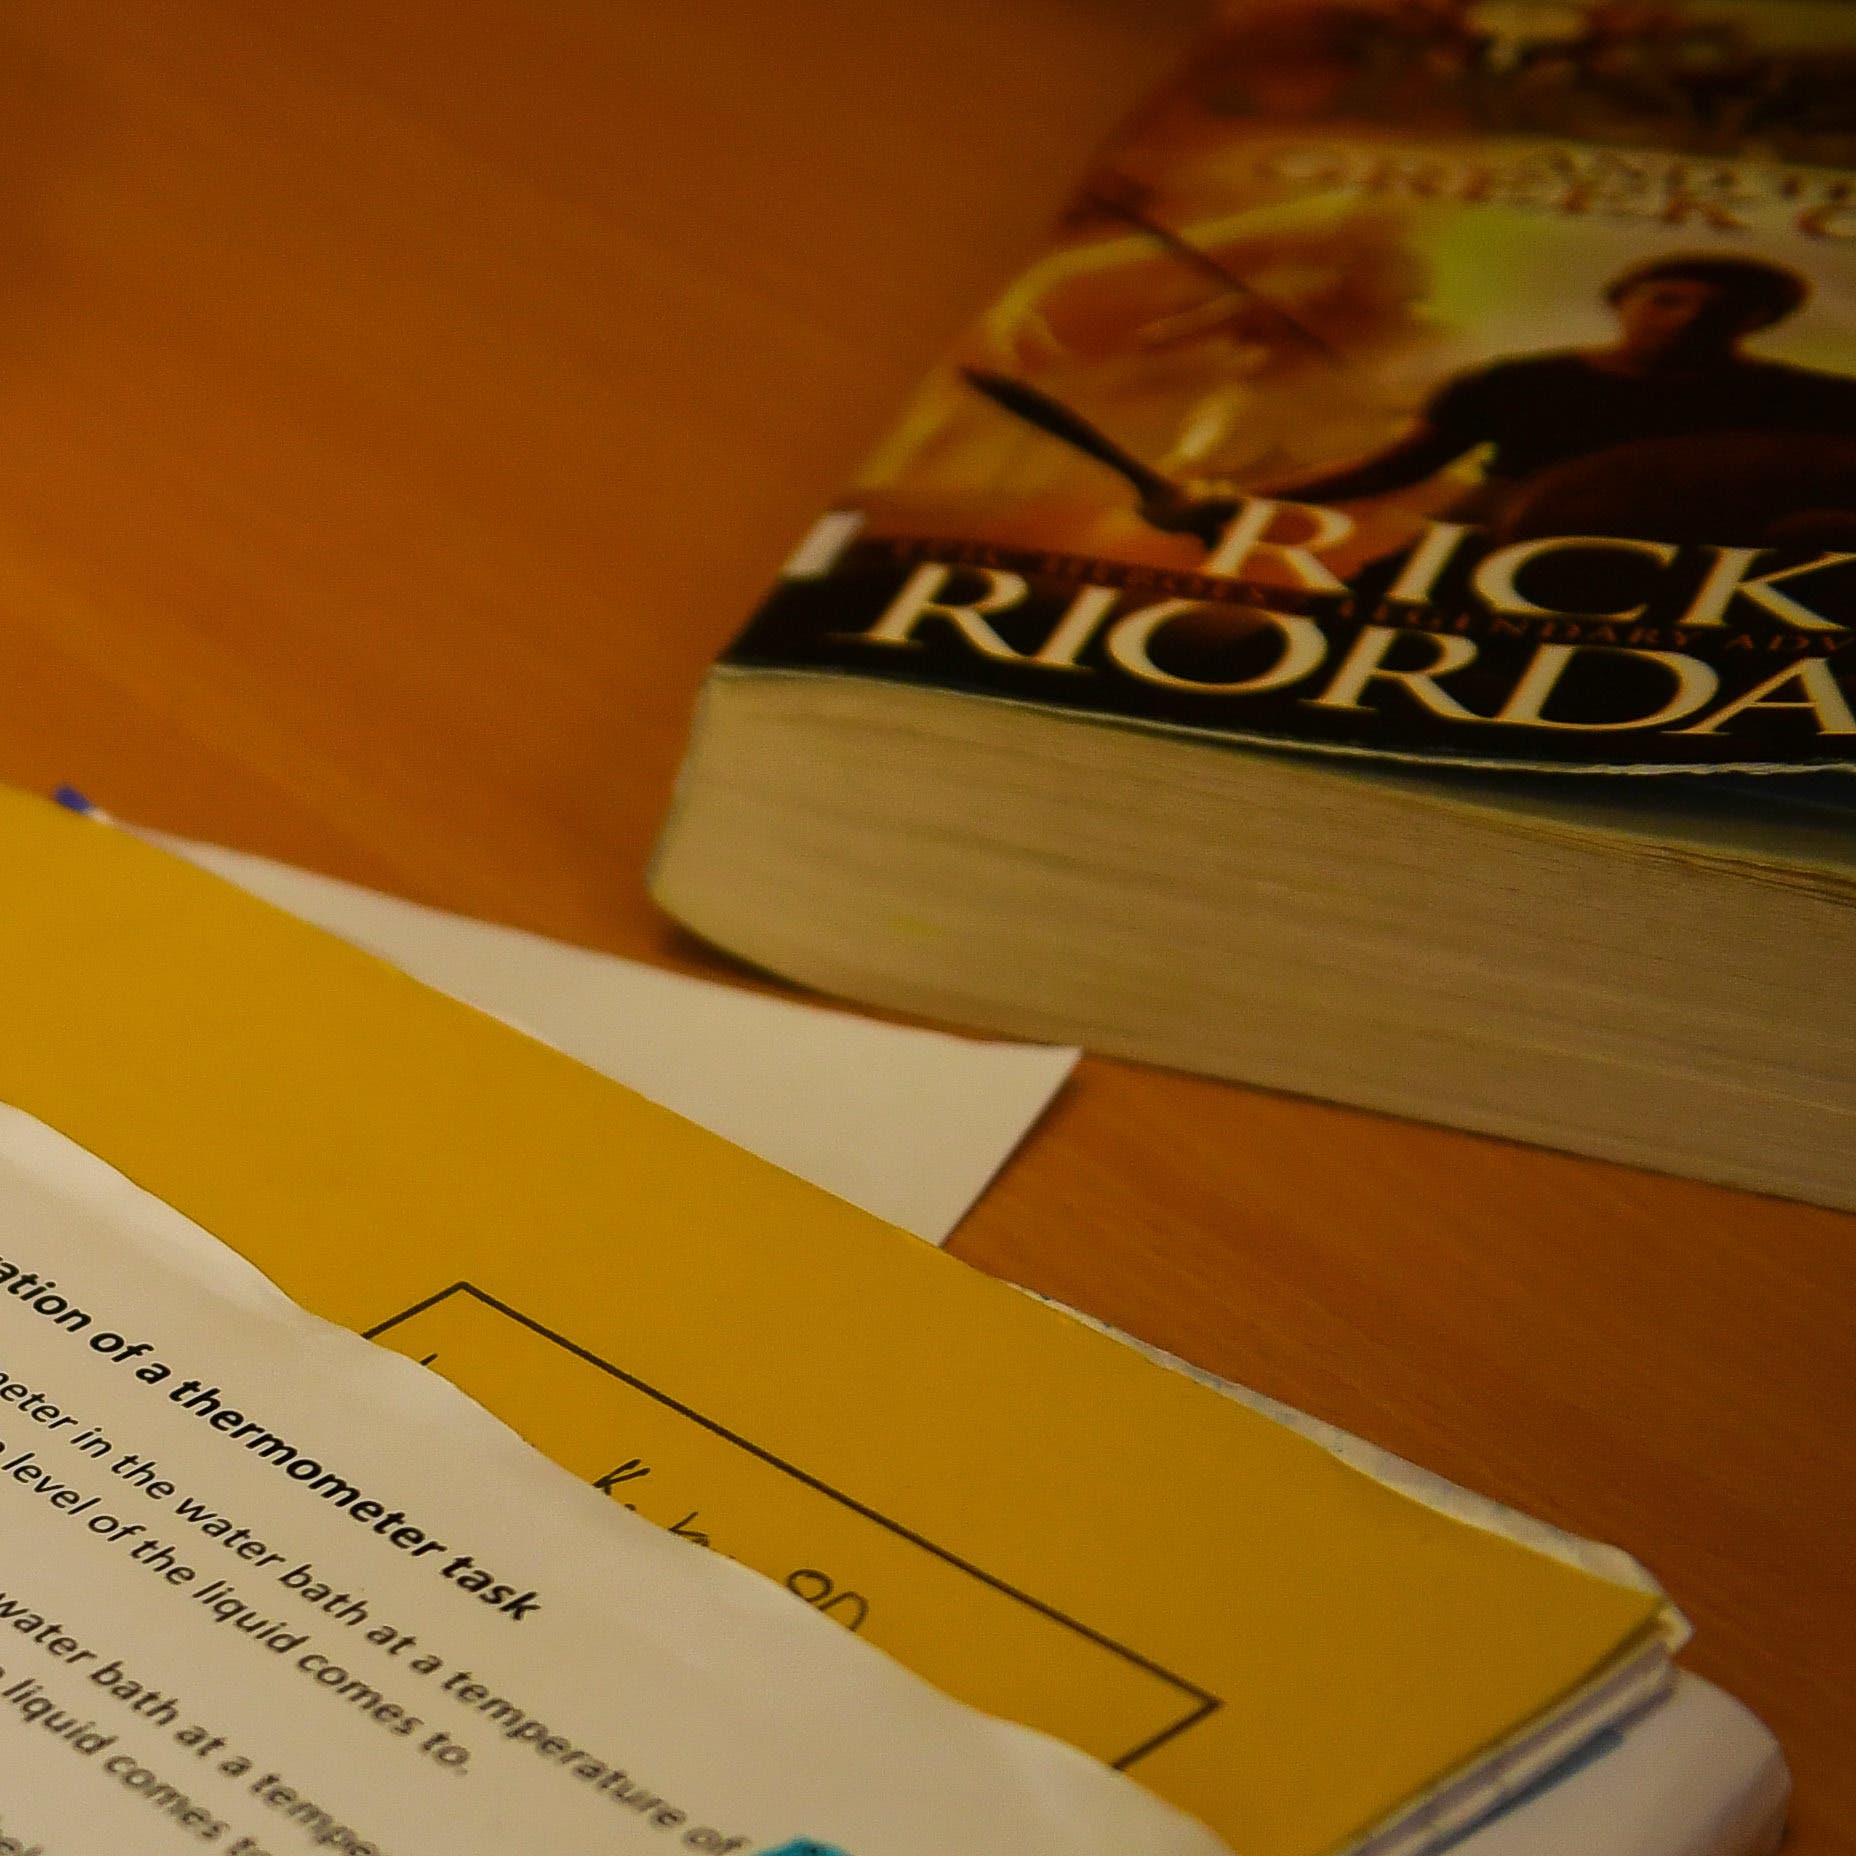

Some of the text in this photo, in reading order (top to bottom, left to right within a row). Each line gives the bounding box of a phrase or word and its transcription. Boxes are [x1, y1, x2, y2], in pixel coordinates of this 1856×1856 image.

[1200, 495, 1856, 631] RICK
[89, 1333, 154, 1363] of
[135, 1363, 171, 1384] a
[168, 1381, 447, 1557] thermometer
[439, 1557, 541, 1622] task
[0, 1453, 102, 1516] level
[86, 1516, 147, 1542] of
[128, 1541, 195, 1587] the
[191, 1581, 310, 1655] liquid
[294, 1655, 423, 1737] comes
[418, 1733, 470, 1776] to.
[69, 1428, 112, 1458] in
[110, 1456, 175, 1500] the
[174, 1498, 286, 1567] water
[277, 1564, 368, 1627] bath
[364, 1626, 416, 1657] at
[408, 1655, 442, 1676] a
[440, 1673, 685, 1829] temperature
[87, 1662, 178, 1727] bath
[174, 1727, 225, 1759] at
[217, 1757, 252, 1778] a
[102, 1756, 229, 1843] comes
